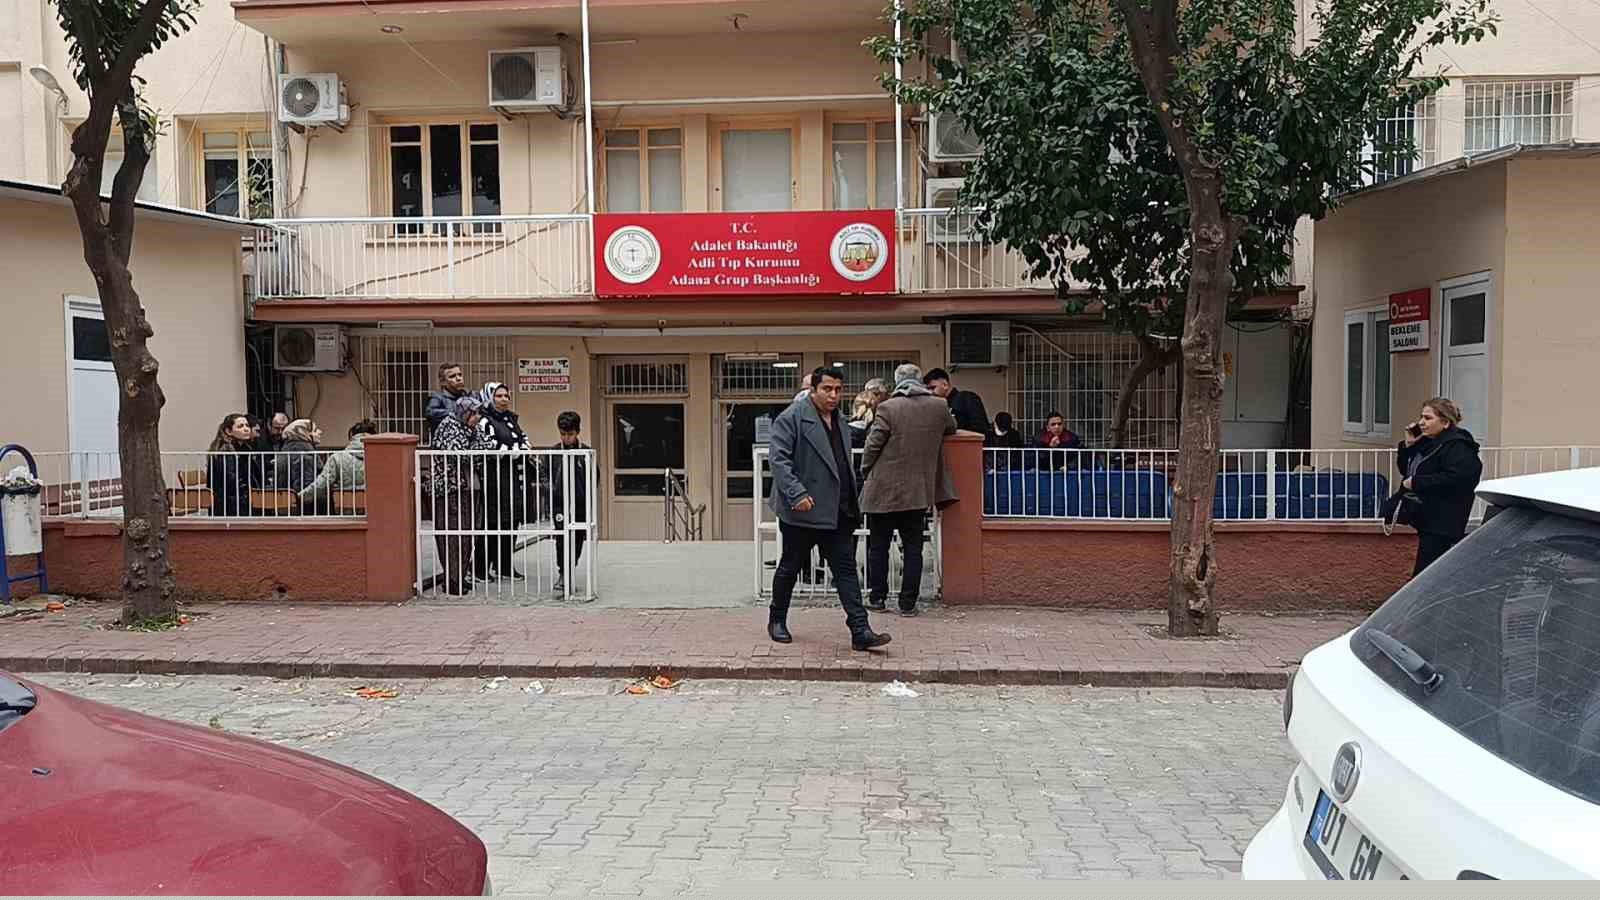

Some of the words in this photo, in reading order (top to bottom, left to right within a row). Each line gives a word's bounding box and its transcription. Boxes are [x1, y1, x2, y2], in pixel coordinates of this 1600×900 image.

[729, 222, 758, 234] T.C.
[690, 240, 732, 251] Adalet
[736, 239, 798, 253] Bakanlığı
[688, 257, 716, 268] Adli
[718, 256, 741, 270] Tıp
[744, 256, 800, 268] Kurumu
[669, 274, 711, 286] Adana
[714, 273, 749, 288] Grup
[752, 273, 821, 287] Başkanlığı
[1321, 802, 1347, 857] 01
